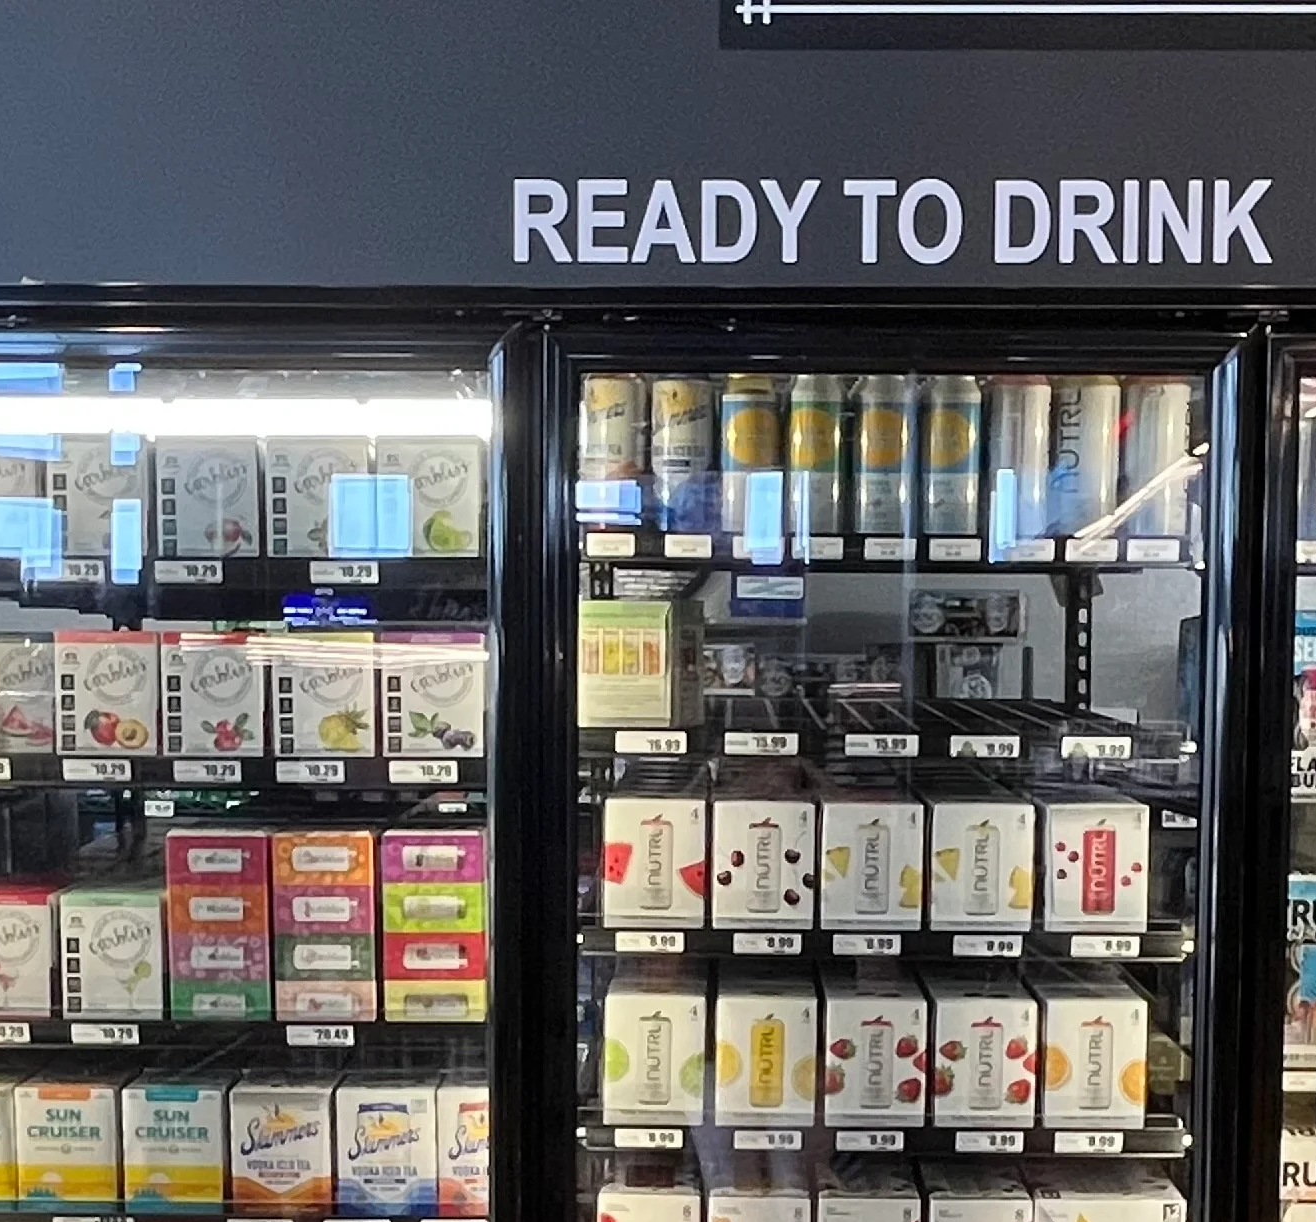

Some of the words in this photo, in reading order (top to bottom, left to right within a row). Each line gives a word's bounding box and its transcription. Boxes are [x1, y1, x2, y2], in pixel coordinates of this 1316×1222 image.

[512, 178, 819, 264] READY
[845, 178, 963, 264] TO
[994, 178, 1273, 264] DRINK
[46, 1108, 81, 1123] SUN
[153, 1109, 190, 1124] SUN
[27, 1125, 101, 1140] CRUISER
[135, 1126, 209, 1141] CRUISER
